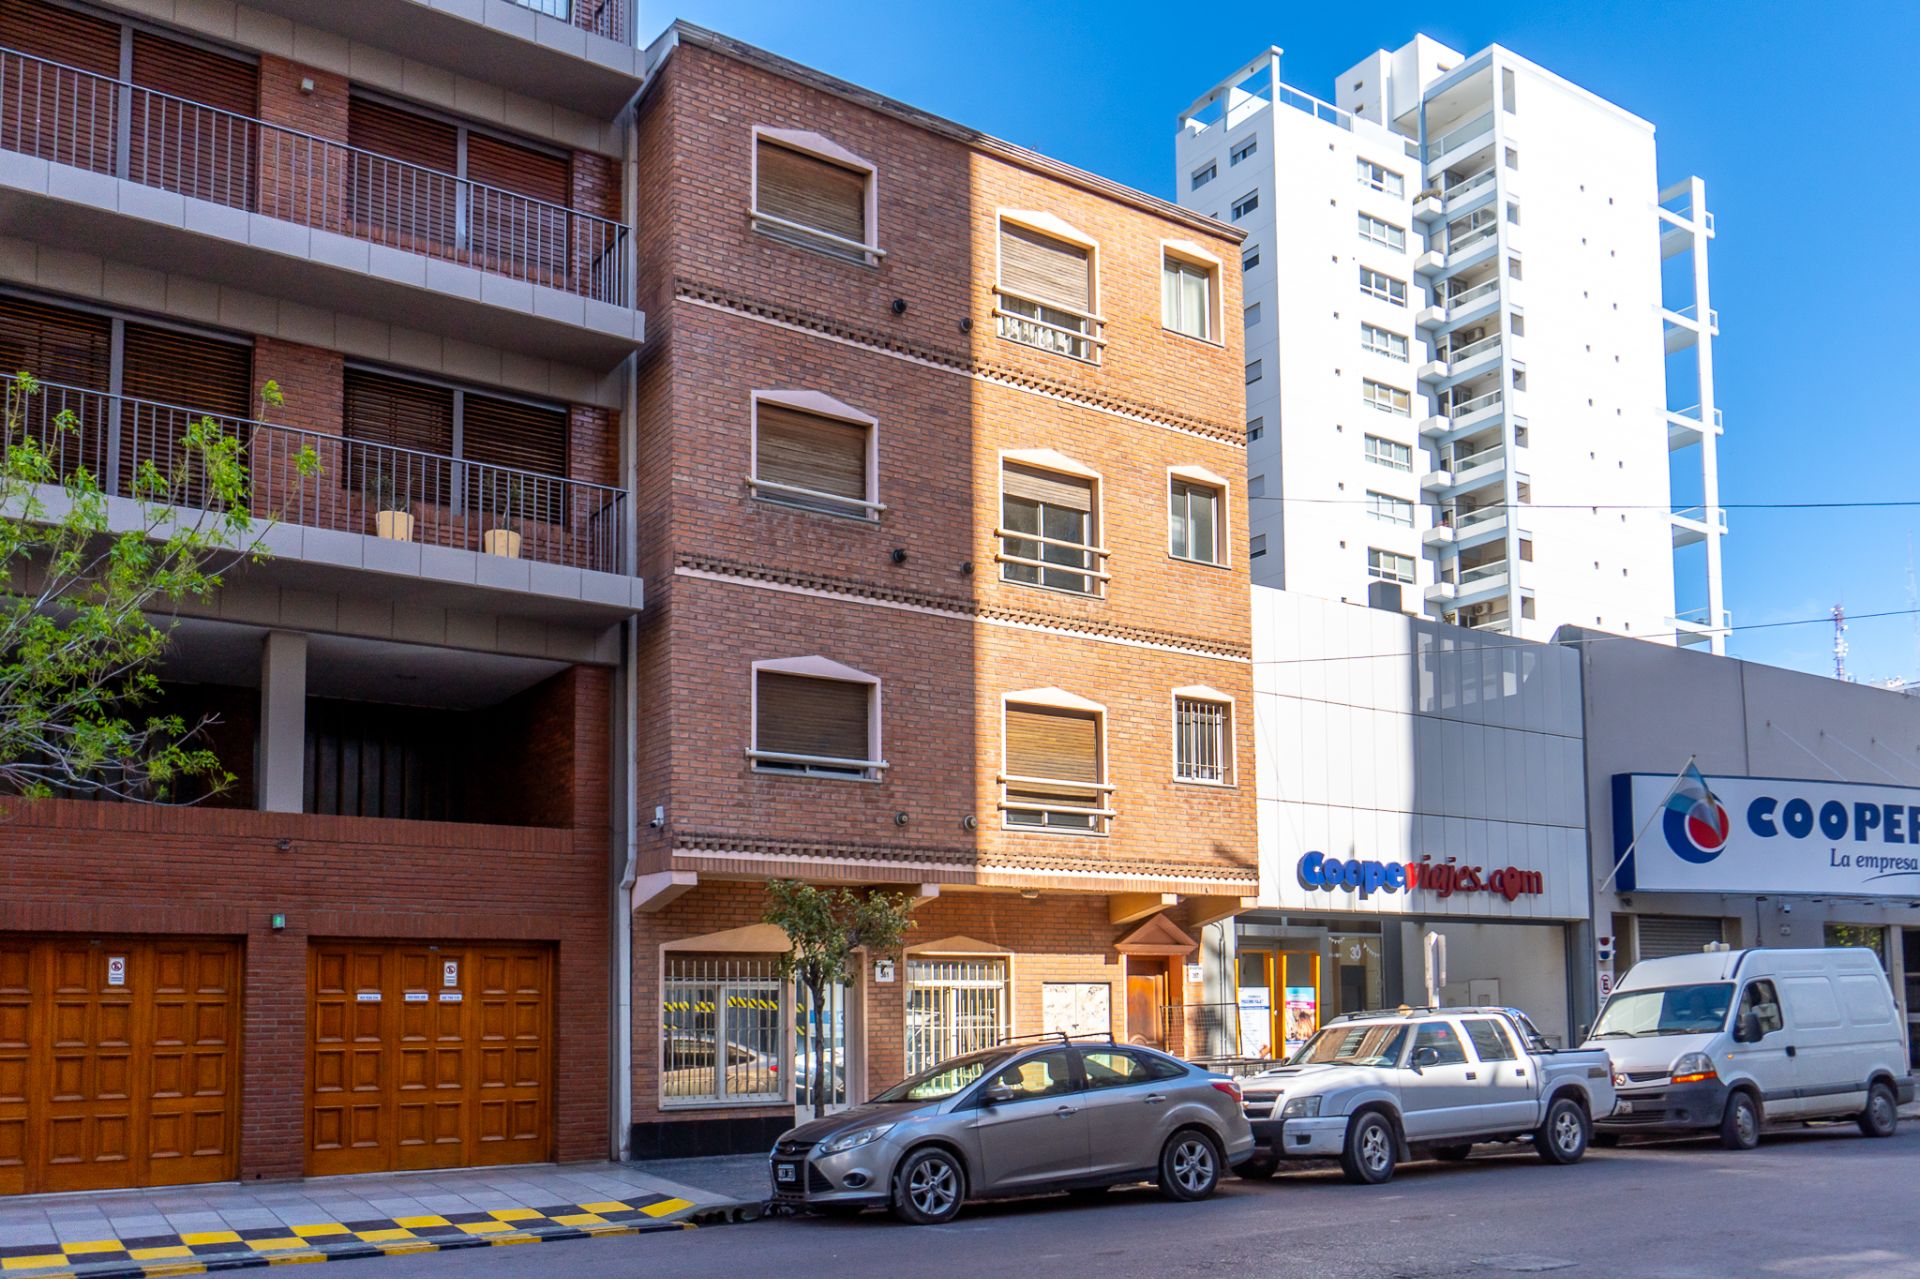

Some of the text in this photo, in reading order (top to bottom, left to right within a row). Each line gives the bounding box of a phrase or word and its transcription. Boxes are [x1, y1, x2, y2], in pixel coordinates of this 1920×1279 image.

[1297, 850, 1543, 902] Coopeviajes.com
[1830, 848, 1918, 873] La empresa
